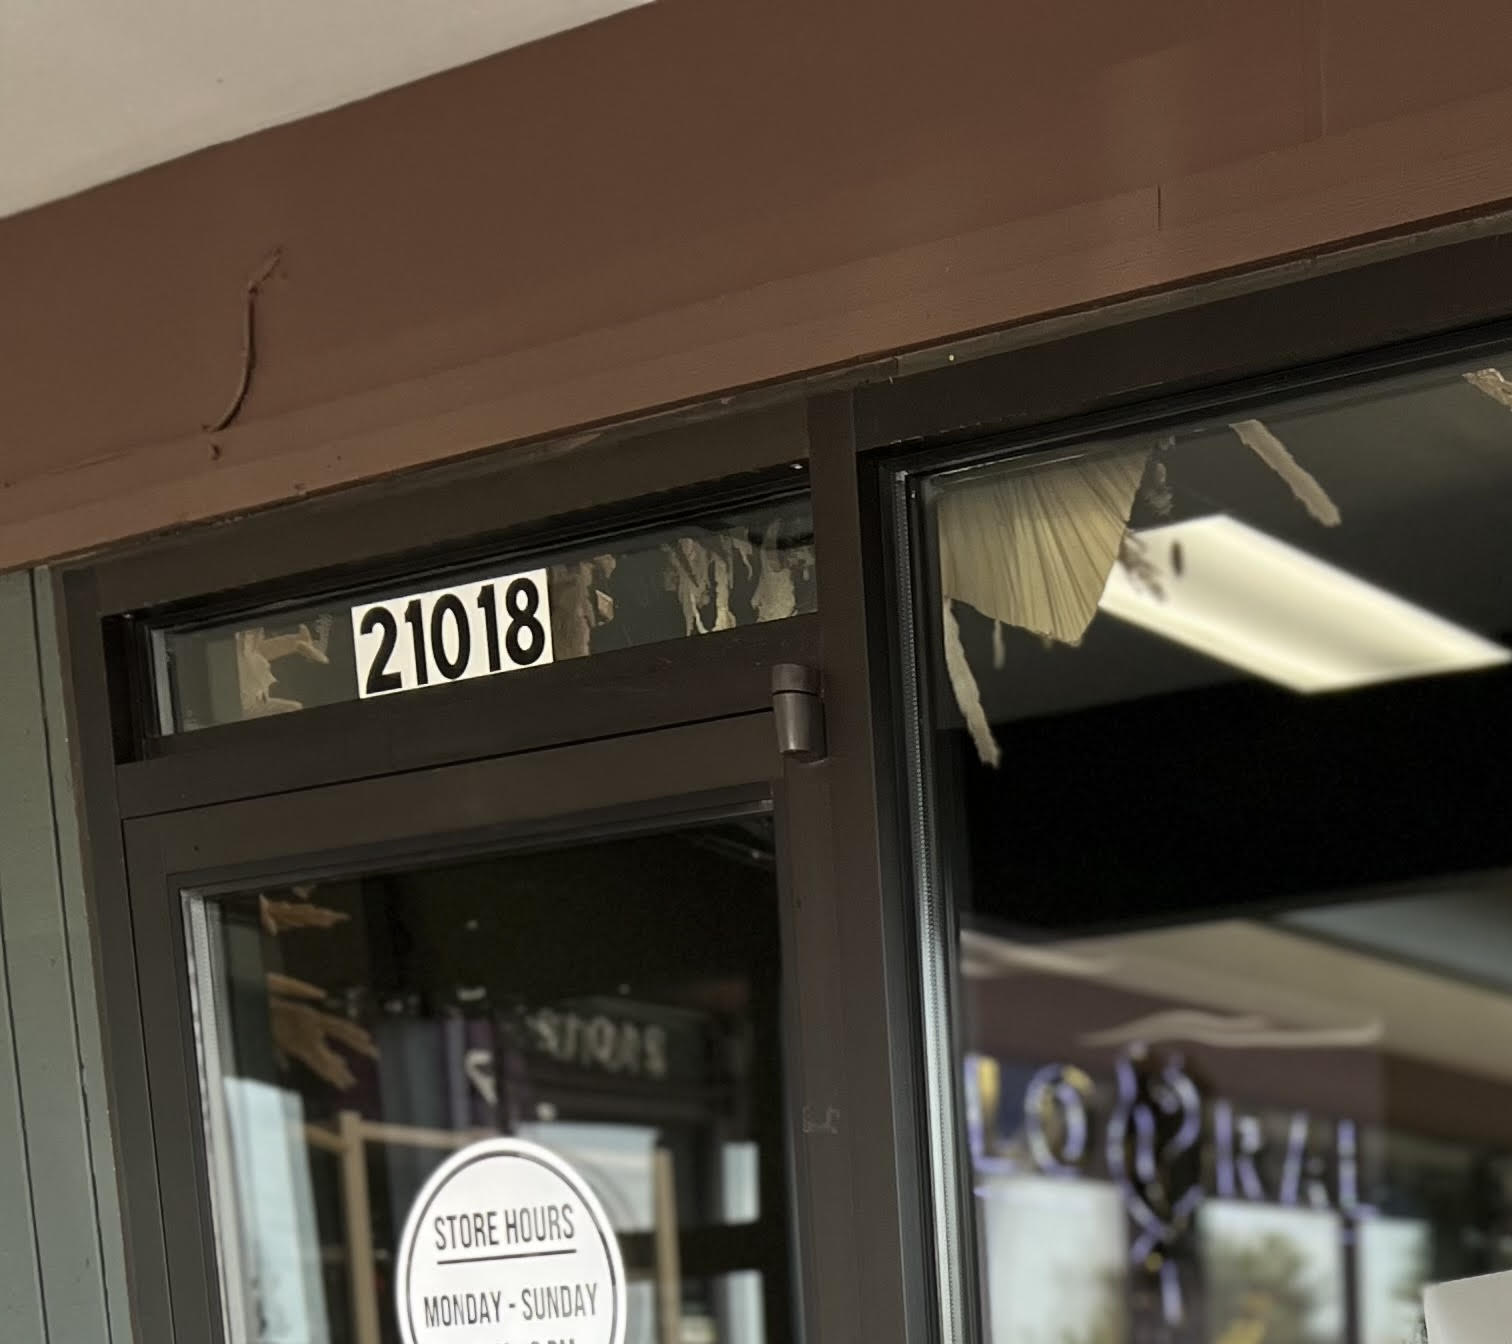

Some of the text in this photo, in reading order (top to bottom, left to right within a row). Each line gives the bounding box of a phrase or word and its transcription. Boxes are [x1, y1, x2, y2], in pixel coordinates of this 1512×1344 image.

[359, 577, 547, 695] 21018
[434, 1203, 575, 1250] STORE HOURS
[424, 1291, 502, 1328] MONDAY
[521, 1283, 598, 1321] SUNDAY
